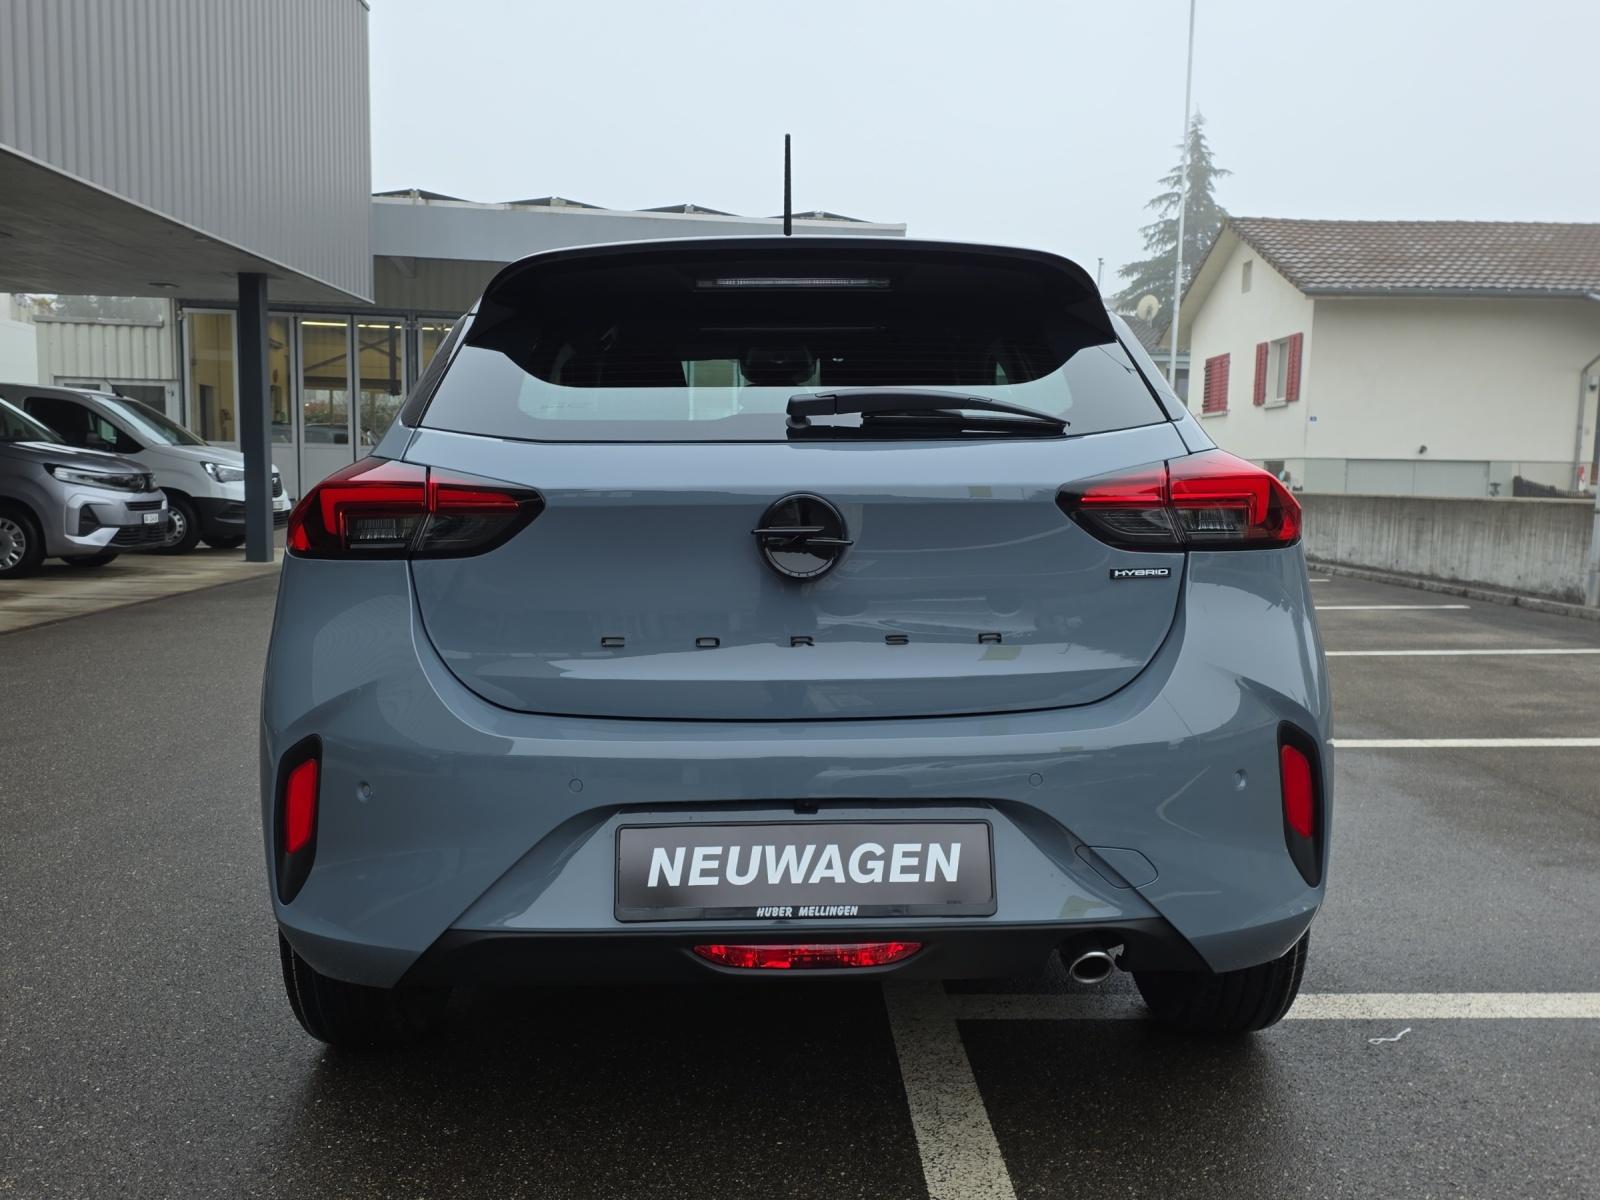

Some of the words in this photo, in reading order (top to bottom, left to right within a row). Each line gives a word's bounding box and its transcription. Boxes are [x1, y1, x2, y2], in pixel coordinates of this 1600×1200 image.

[1114, 568, 1168, 577] HYBRID
[601, 632, 1002, 648] CORSA
[647, 841, 961, 888] NEUWAGEN
[756, 906, 792, 917] HUBER
[798, 905, 858, 917] MELLINGEN
